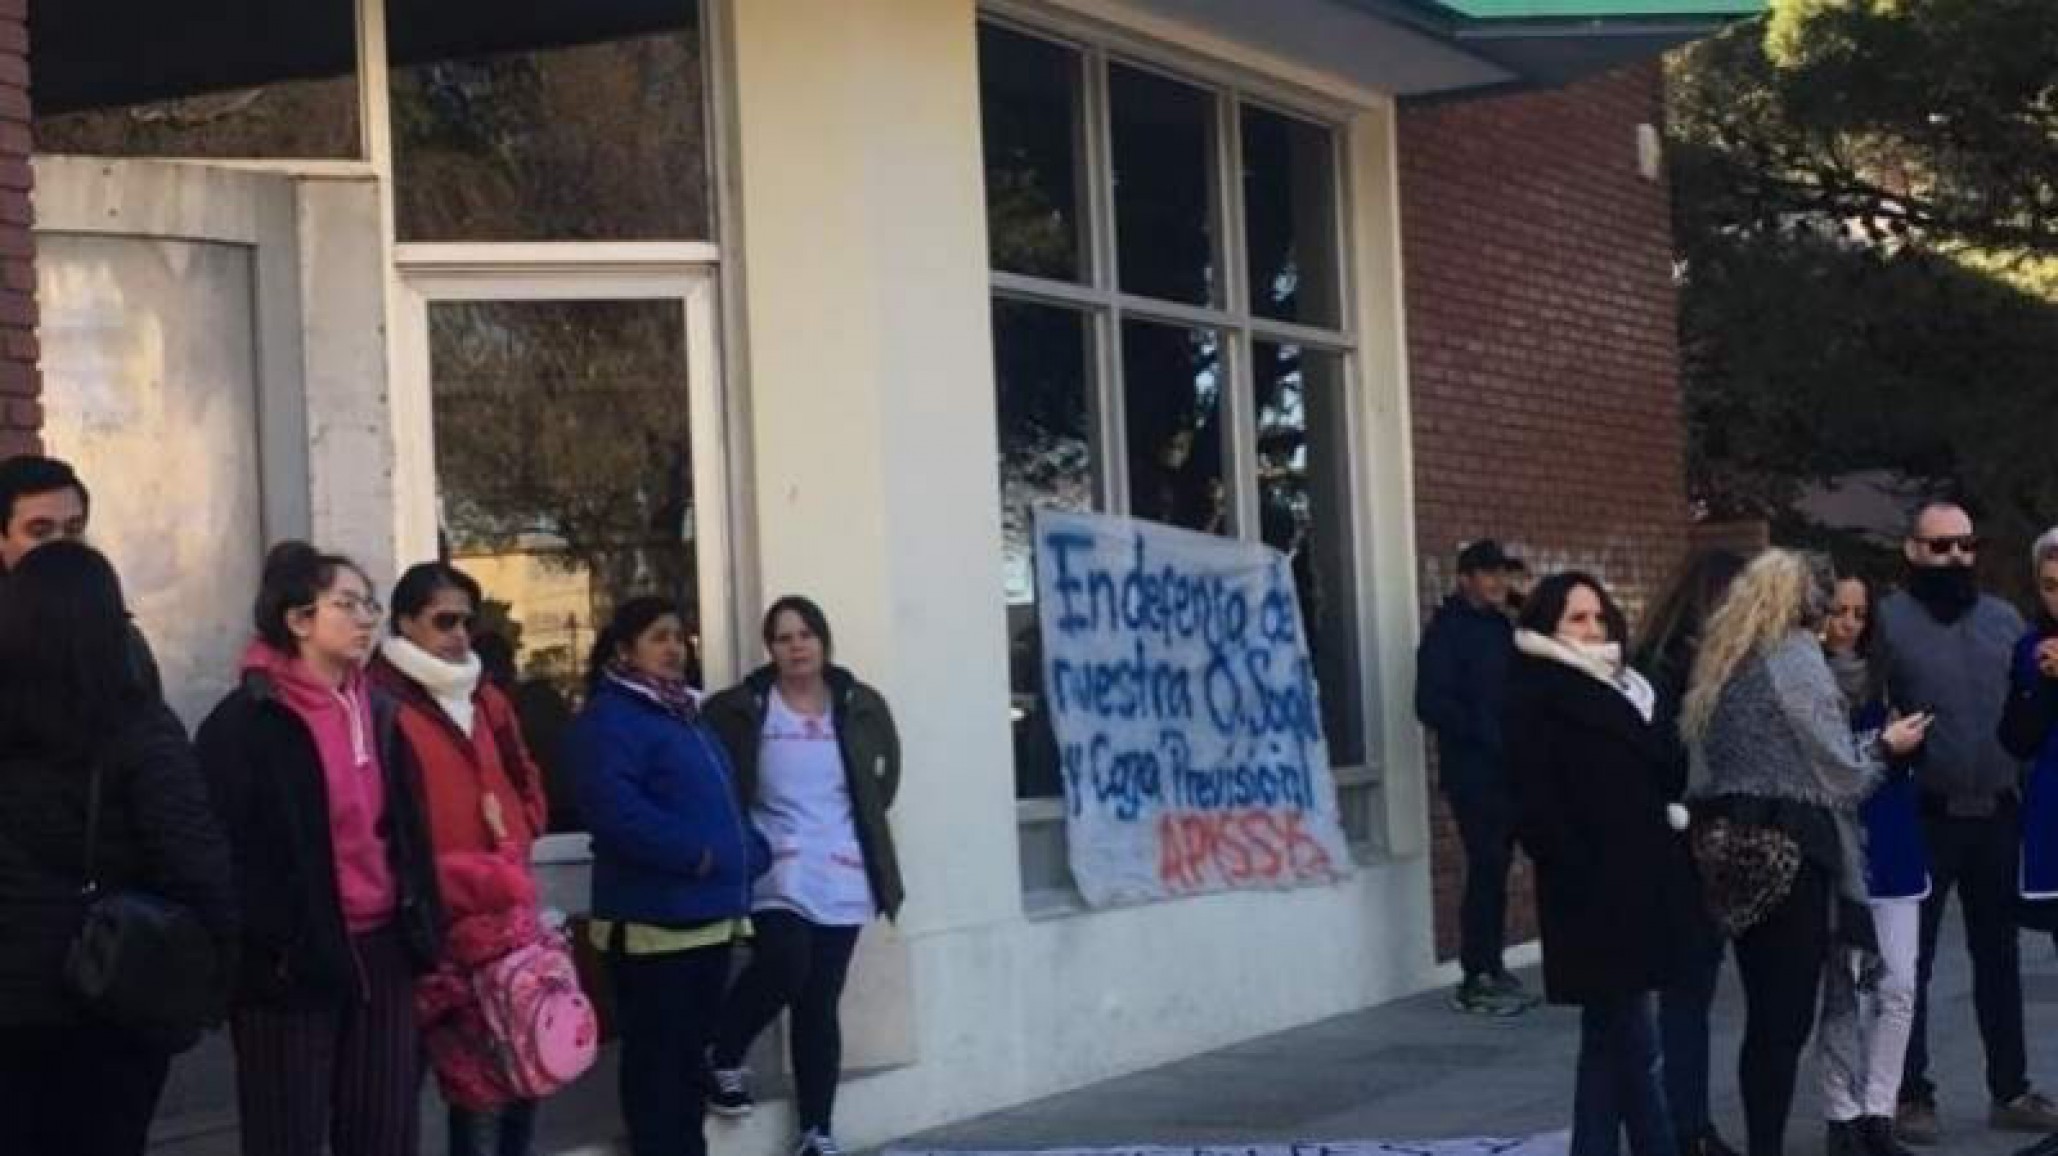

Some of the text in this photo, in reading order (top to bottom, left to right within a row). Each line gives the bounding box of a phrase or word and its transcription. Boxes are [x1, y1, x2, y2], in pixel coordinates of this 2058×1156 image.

[1047, 532, 1118, 634] En
[1052, 640, 1193, 721] nuestra
[1065, 742, 1082, 817] y
